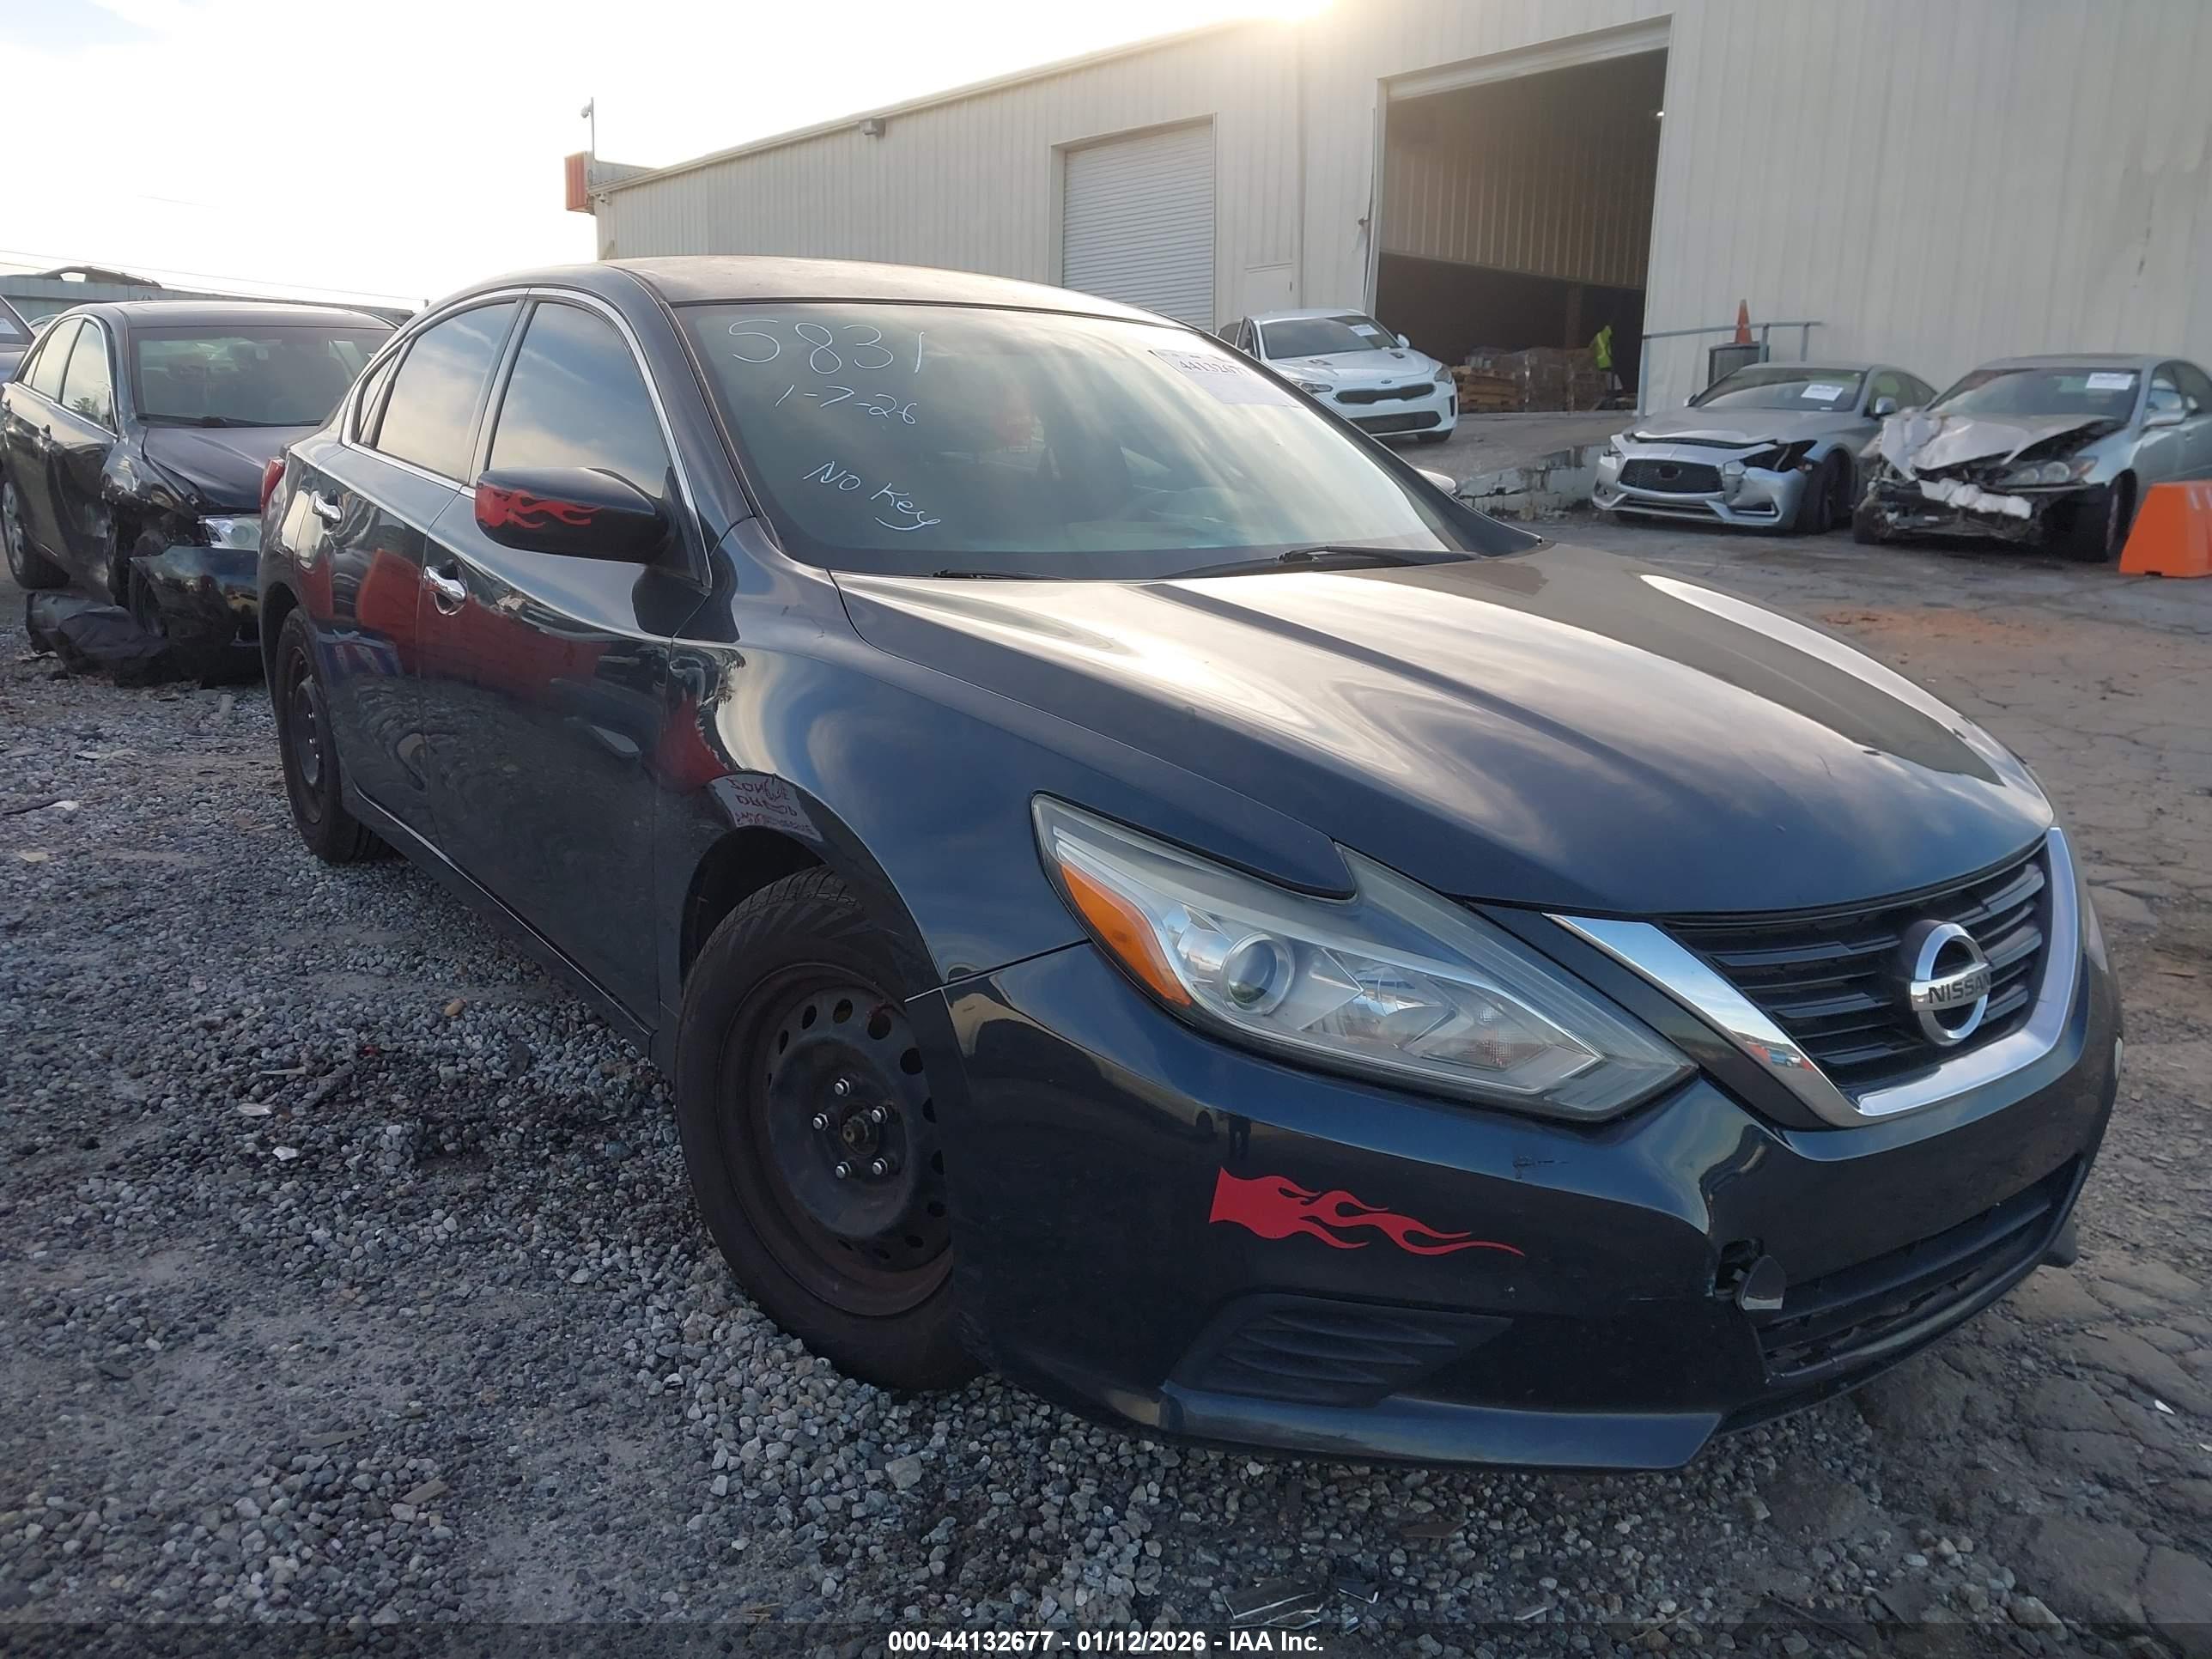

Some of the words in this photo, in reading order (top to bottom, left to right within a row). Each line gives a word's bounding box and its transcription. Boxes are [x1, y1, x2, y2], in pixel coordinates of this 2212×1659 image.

[729, 319, 926, 374] 5831
[775, 384, 918, 424] 1-7-26
[1928, 970, 1992, 1004] NISSAN
